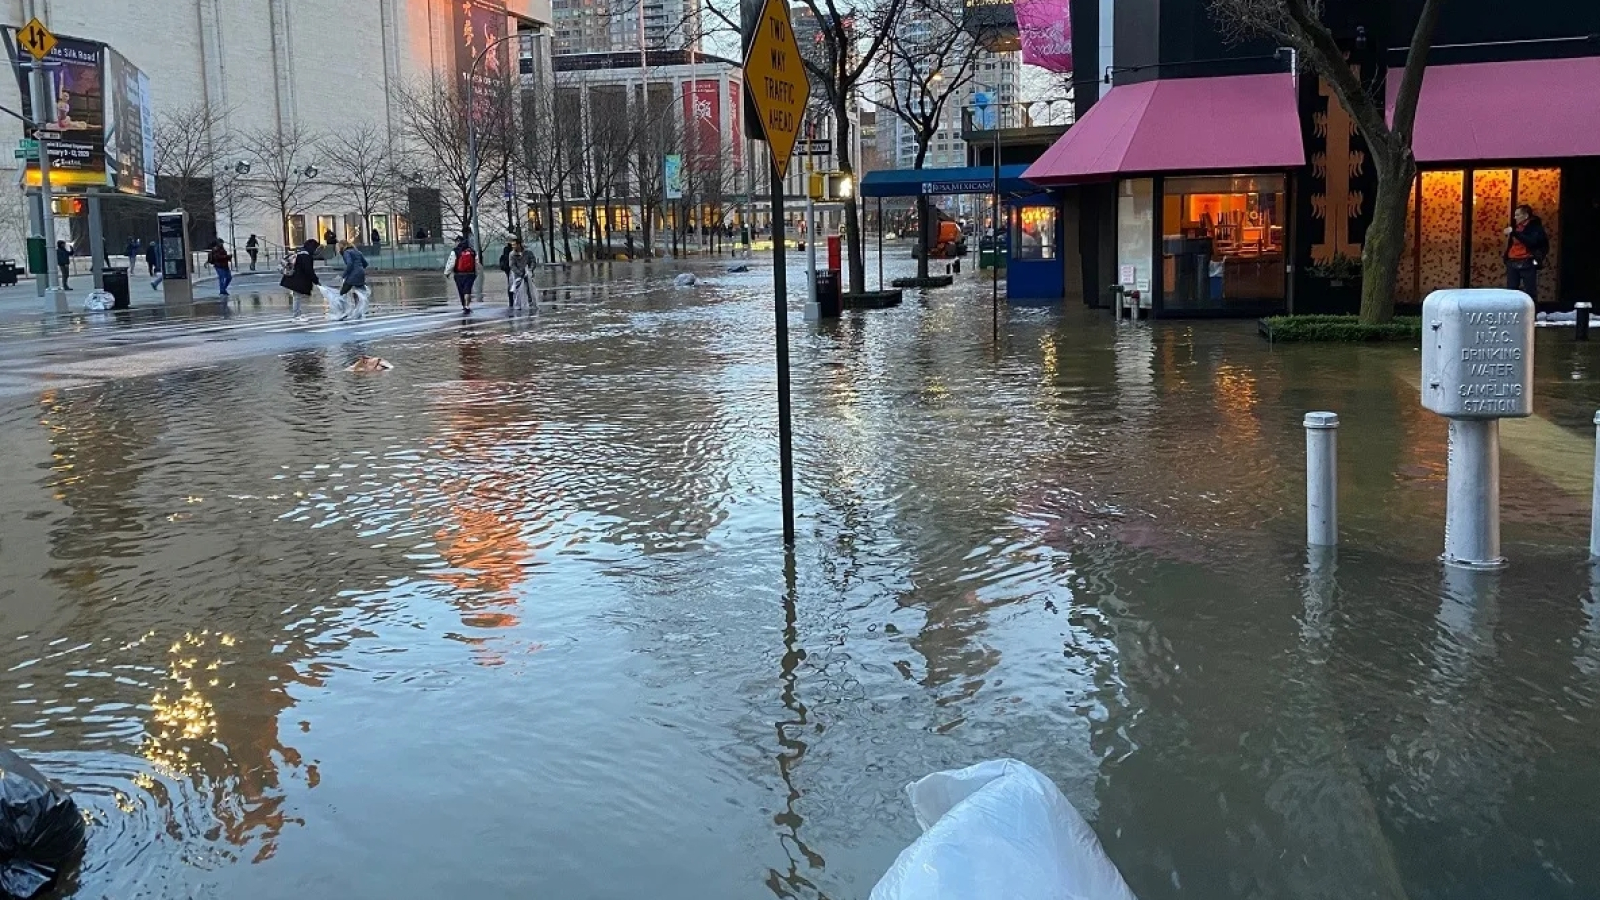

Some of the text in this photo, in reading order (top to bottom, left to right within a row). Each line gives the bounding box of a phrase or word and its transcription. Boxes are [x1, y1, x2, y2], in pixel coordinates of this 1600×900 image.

[770, 16, 785, 42] TWO
[64, 48, 77, 58] Silk
[78, 50, 95, 61] Road
[771, 47, 786, 72] WAY
[764, 76, 794, 105] TRAFFIC
[769, 108, 793, 132] AHEAD
[1476, 331, 1513, 344] N.Y.C.
[1461, 347, 1521, 361] DRINKING
[1468, 363, 1514, 376] WATER
[1458, 383, 1522, 397] SAMPLING
[1464, 400, 1516, 412] STATION
